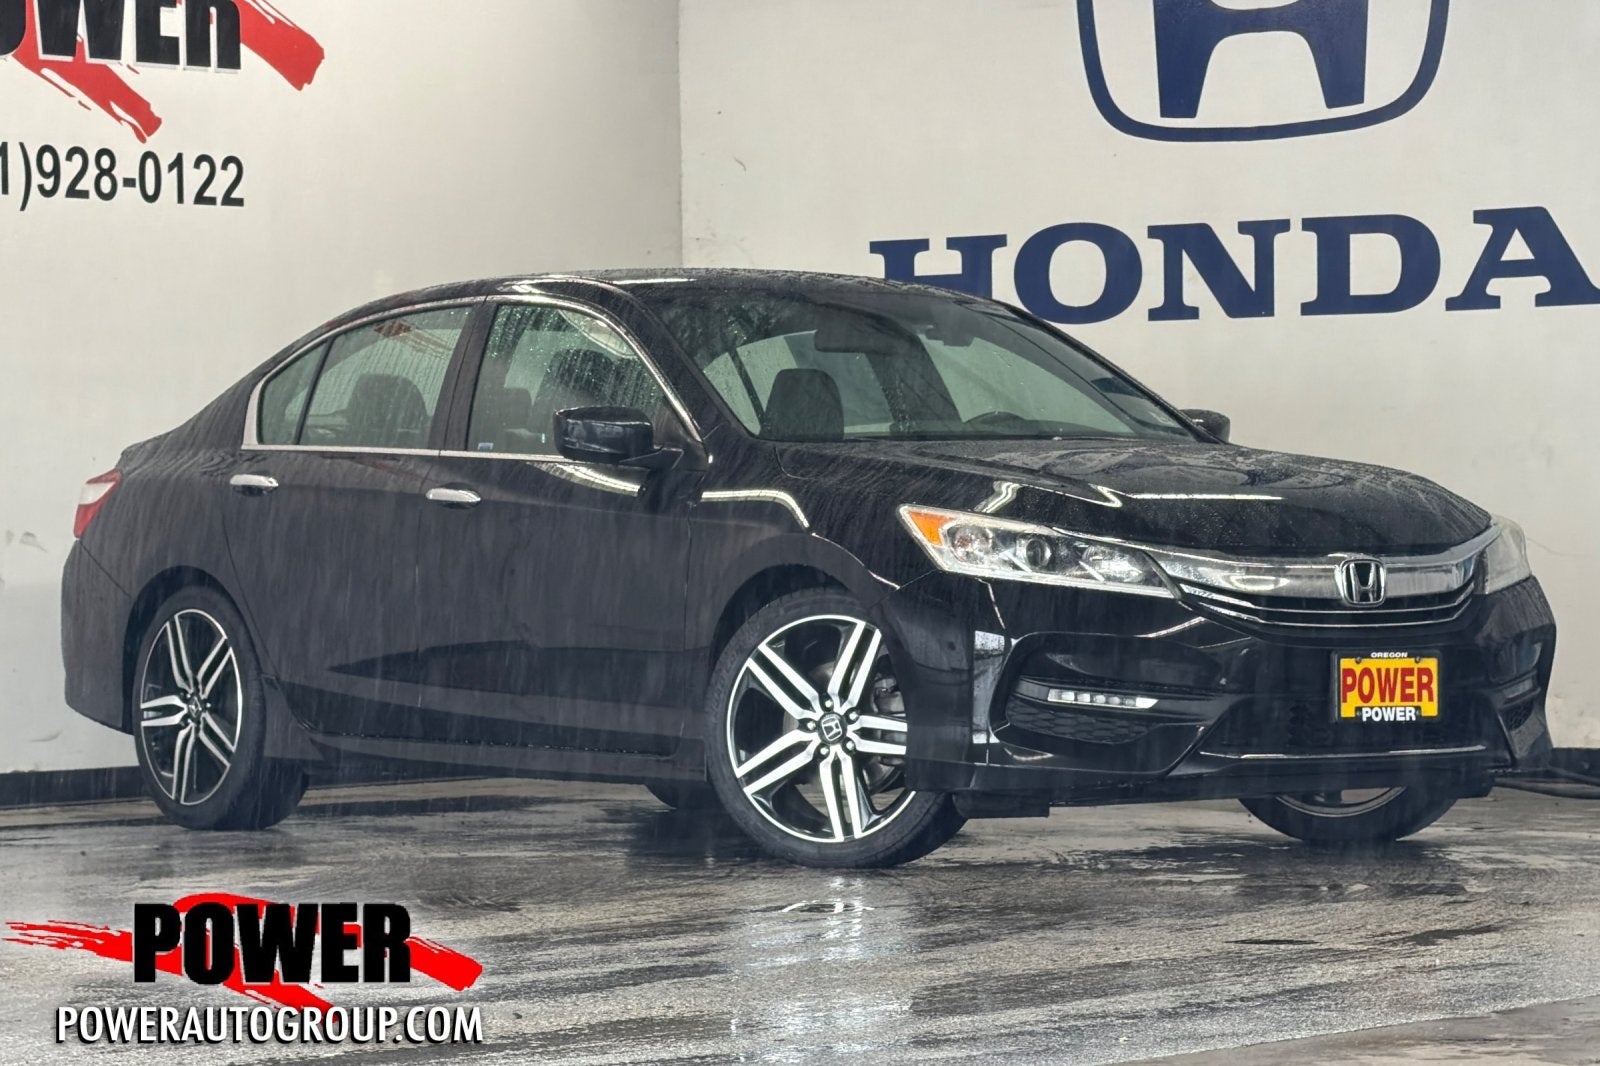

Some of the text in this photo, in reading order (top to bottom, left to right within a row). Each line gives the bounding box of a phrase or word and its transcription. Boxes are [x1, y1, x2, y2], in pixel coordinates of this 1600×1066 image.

[869, 206, 1600, 324] HONDA
[1341, 667, 1434, 703] POWER
[1362, 706, 1417, 722] POWER
